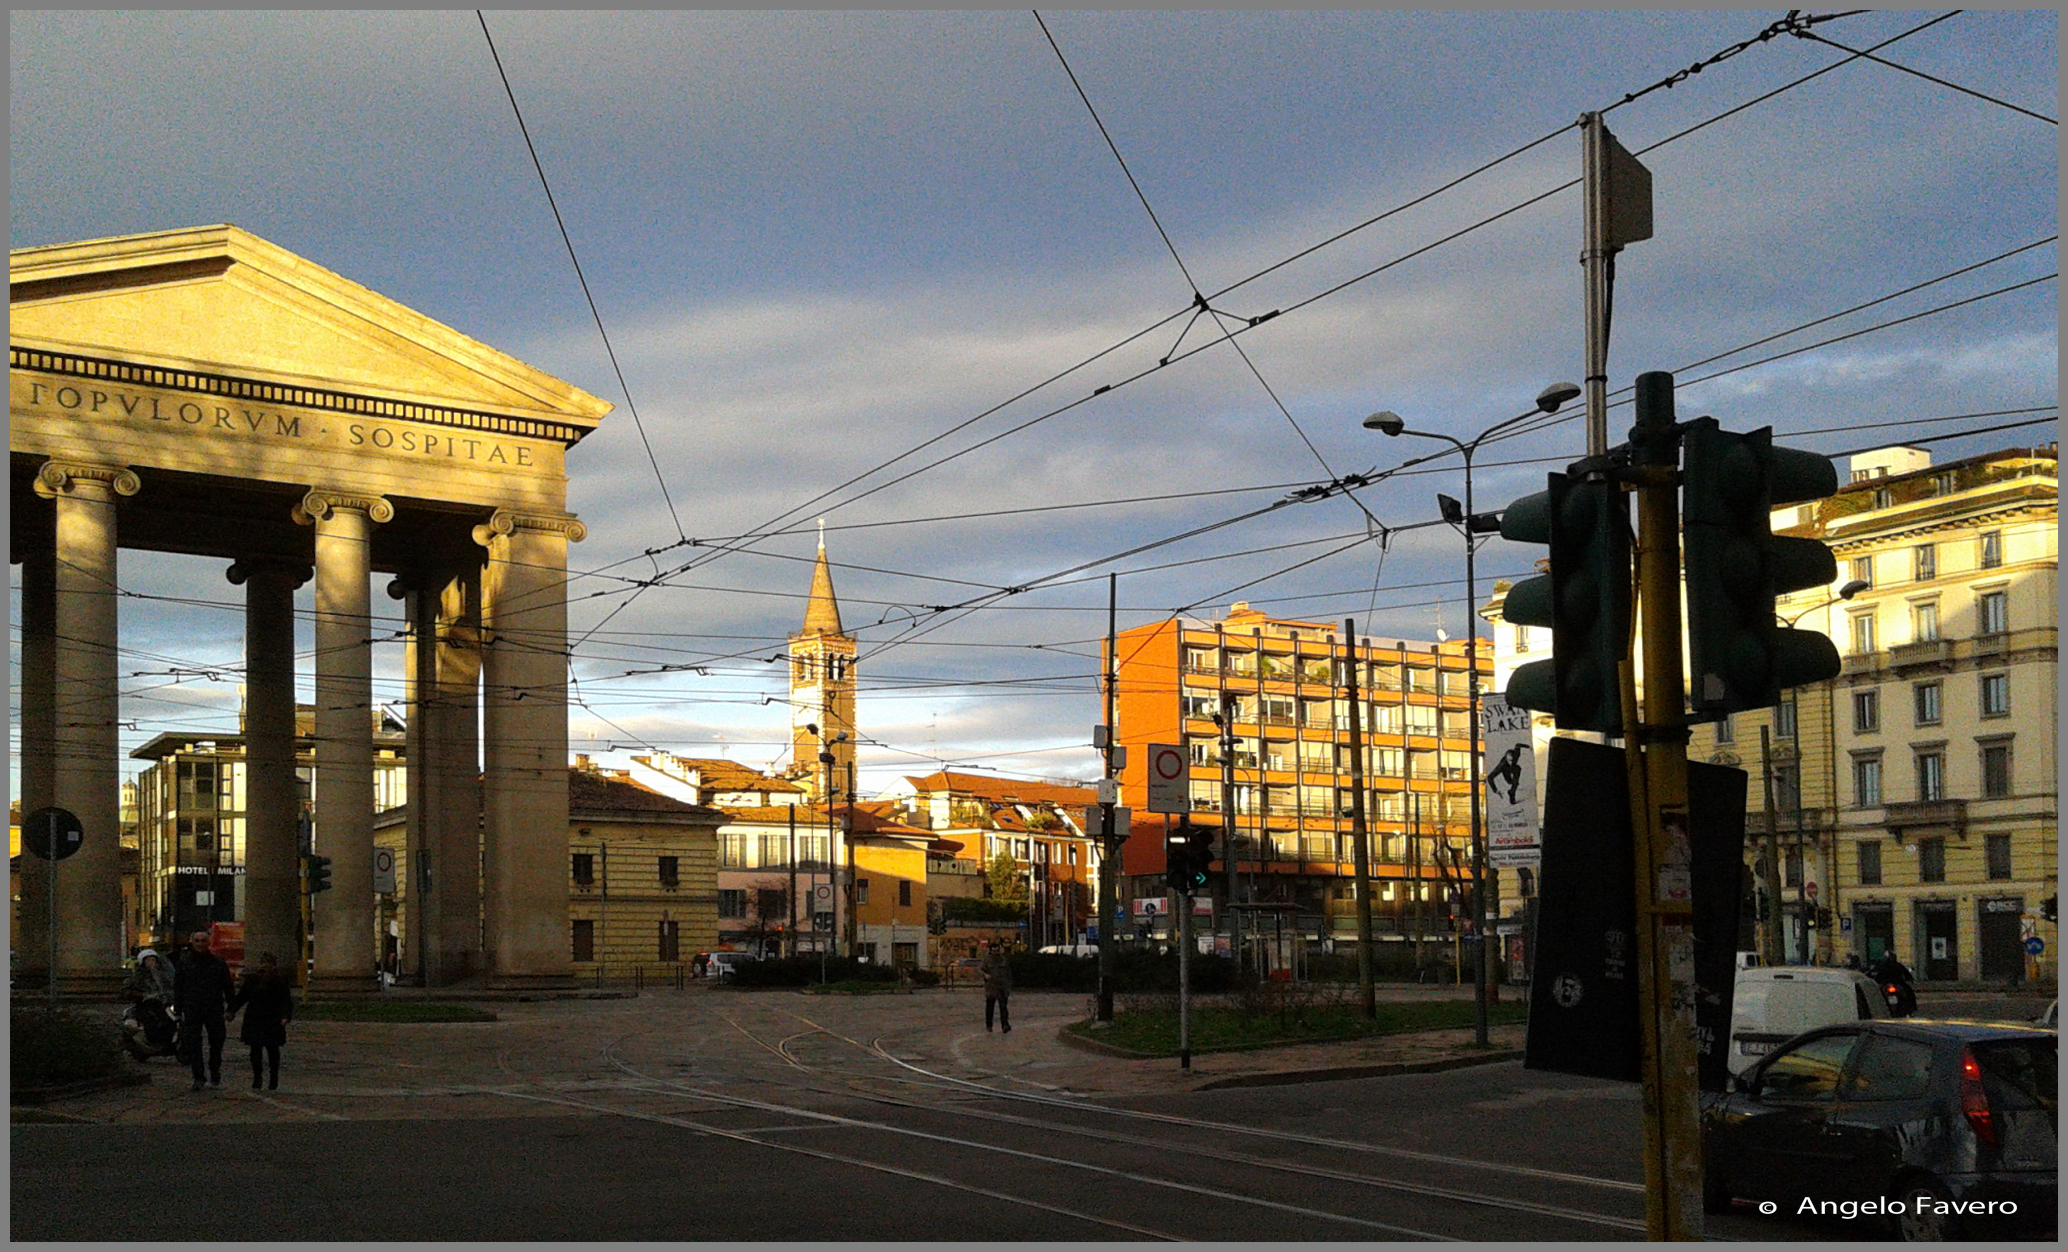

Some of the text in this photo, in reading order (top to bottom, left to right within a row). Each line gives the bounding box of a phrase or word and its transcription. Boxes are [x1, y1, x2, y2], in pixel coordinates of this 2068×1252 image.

[349, 423, 535, 468] SOSPITAE
[1485, 704, 1530, 719] SWAN
[1487, 716, 1531, 733] LAKE
[177, 866, 208, 875] HOTEL
